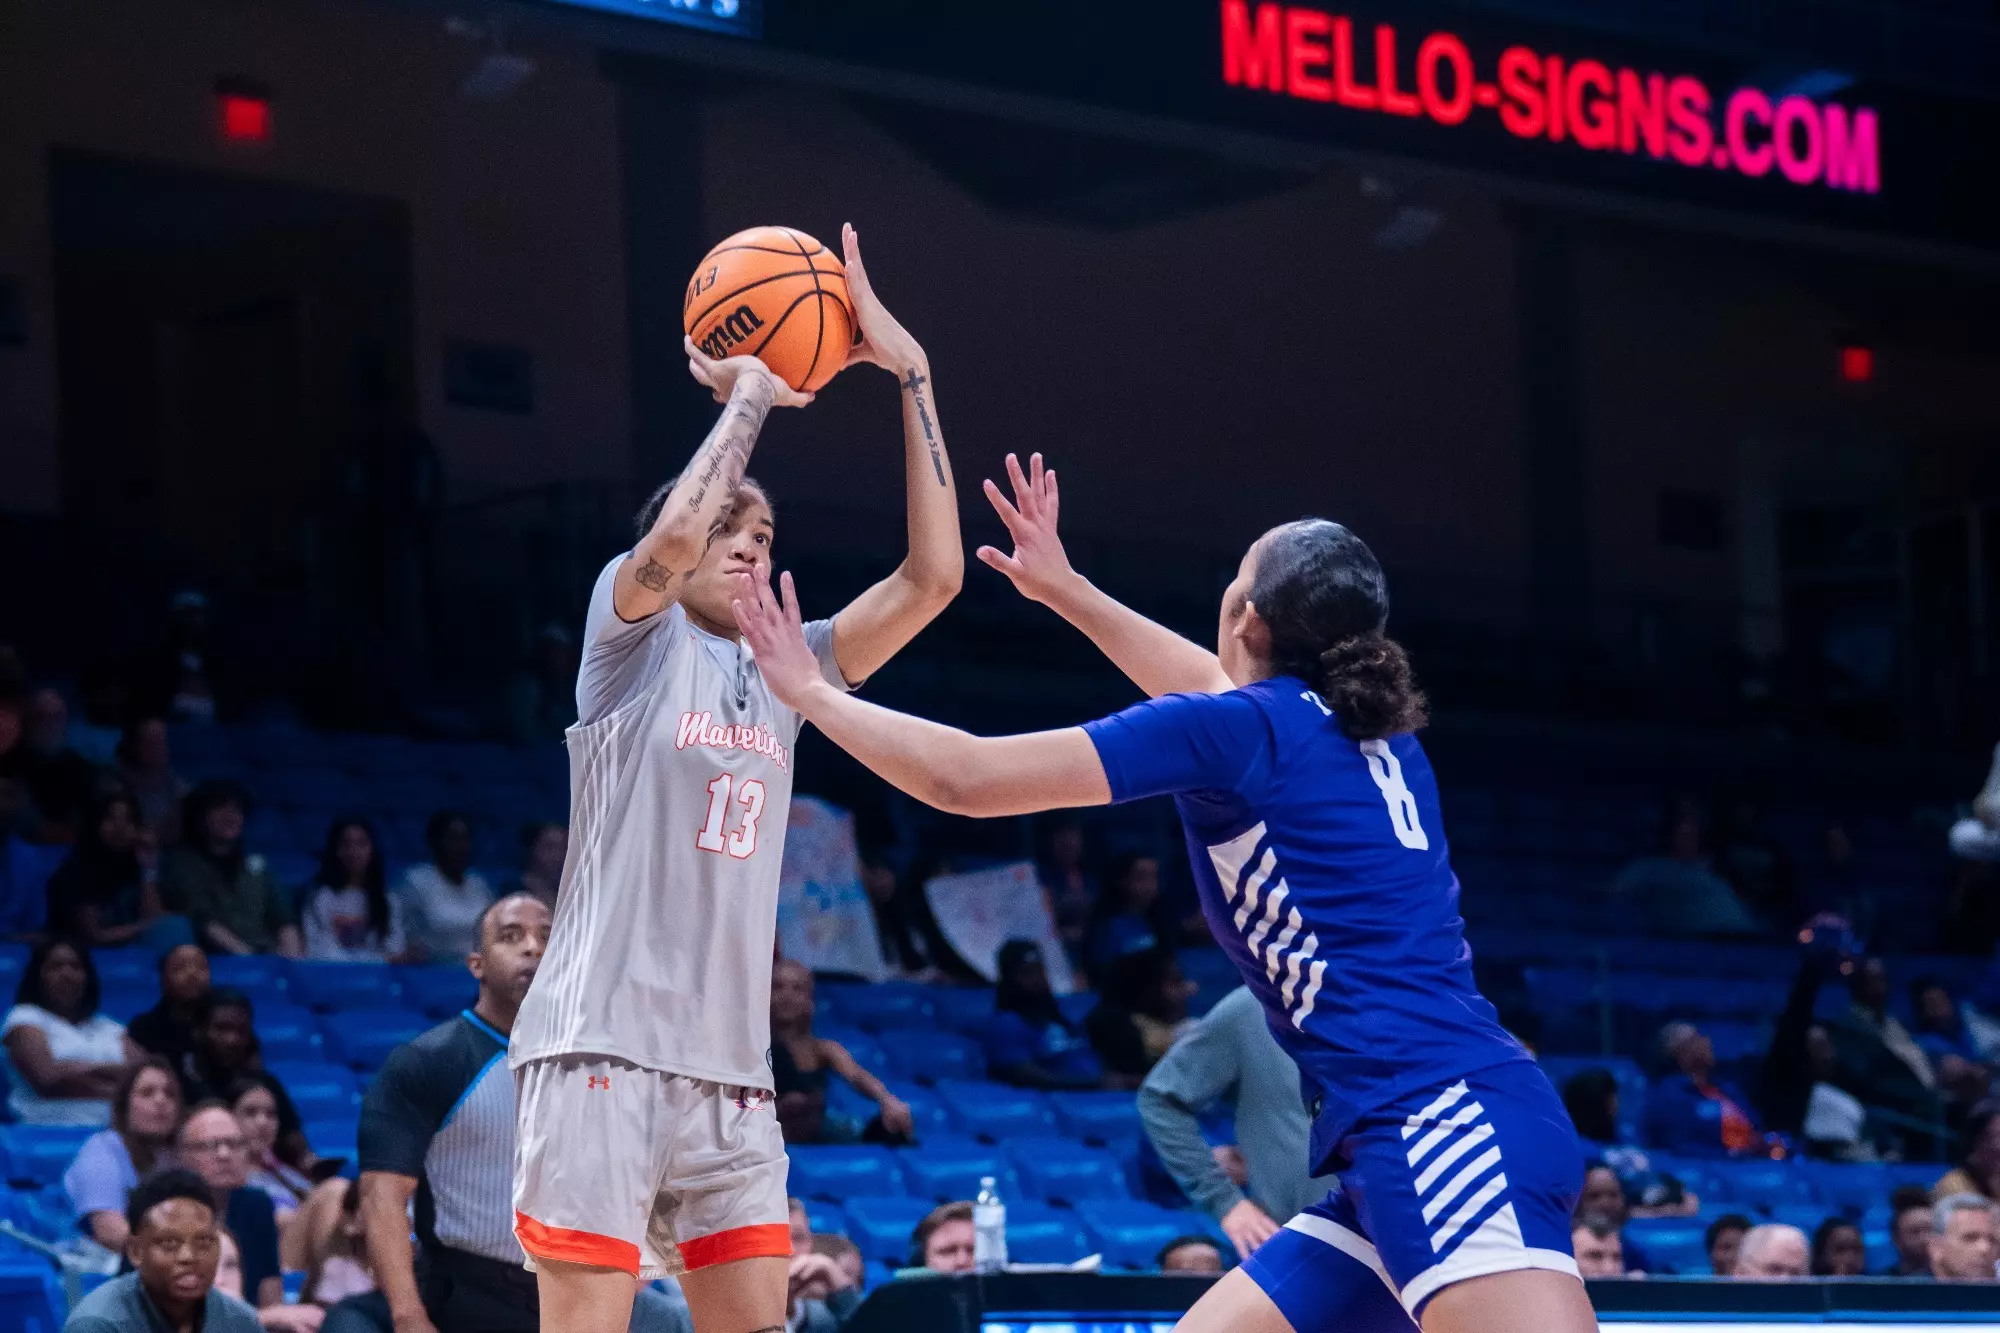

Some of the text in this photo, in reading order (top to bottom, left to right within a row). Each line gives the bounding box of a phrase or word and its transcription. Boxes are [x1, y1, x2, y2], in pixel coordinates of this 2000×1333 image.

[1221, 0, 1880, 193] MELLO-SIGNS.COM
[696, 772, 766, 860] 13
[1359, 738, 1429, 851] 8
